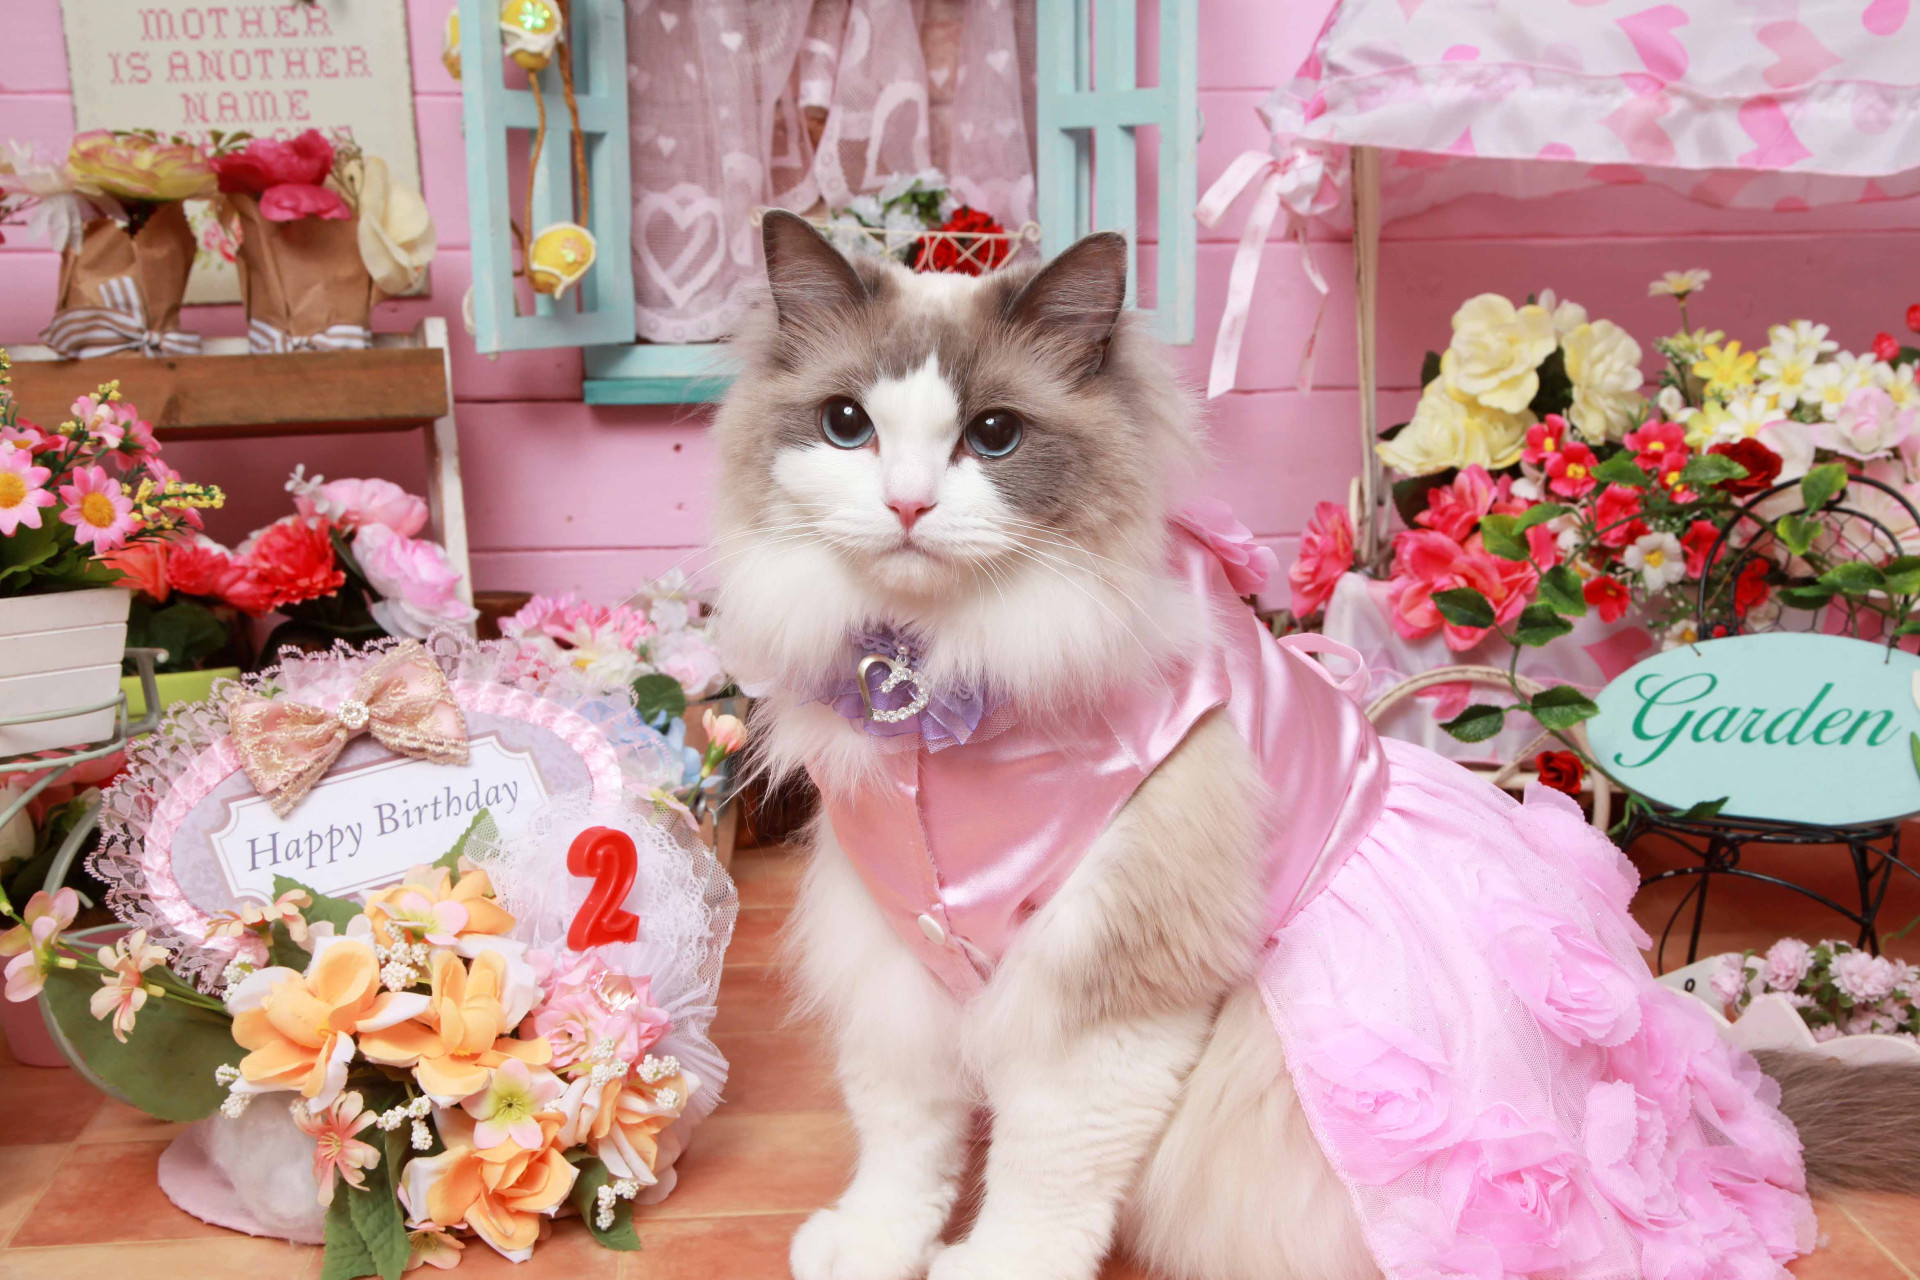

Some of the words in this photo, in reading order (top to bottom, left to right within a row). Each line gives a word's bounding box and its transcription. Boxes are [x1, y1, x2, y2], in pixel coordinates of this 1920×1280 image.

[138, 4, 334, 42] MOTHER
[108, 51, 152, 84] IS
[166, 46, 373, 83] ANOTHER
[180, 89, 312, 124] NAME
[1613, 672, 1902, 768] Garden
[246, 820, 364, 872] Happy
[373, 778, 519, 838] Birthday
[566, 825, 640, 952] 2
